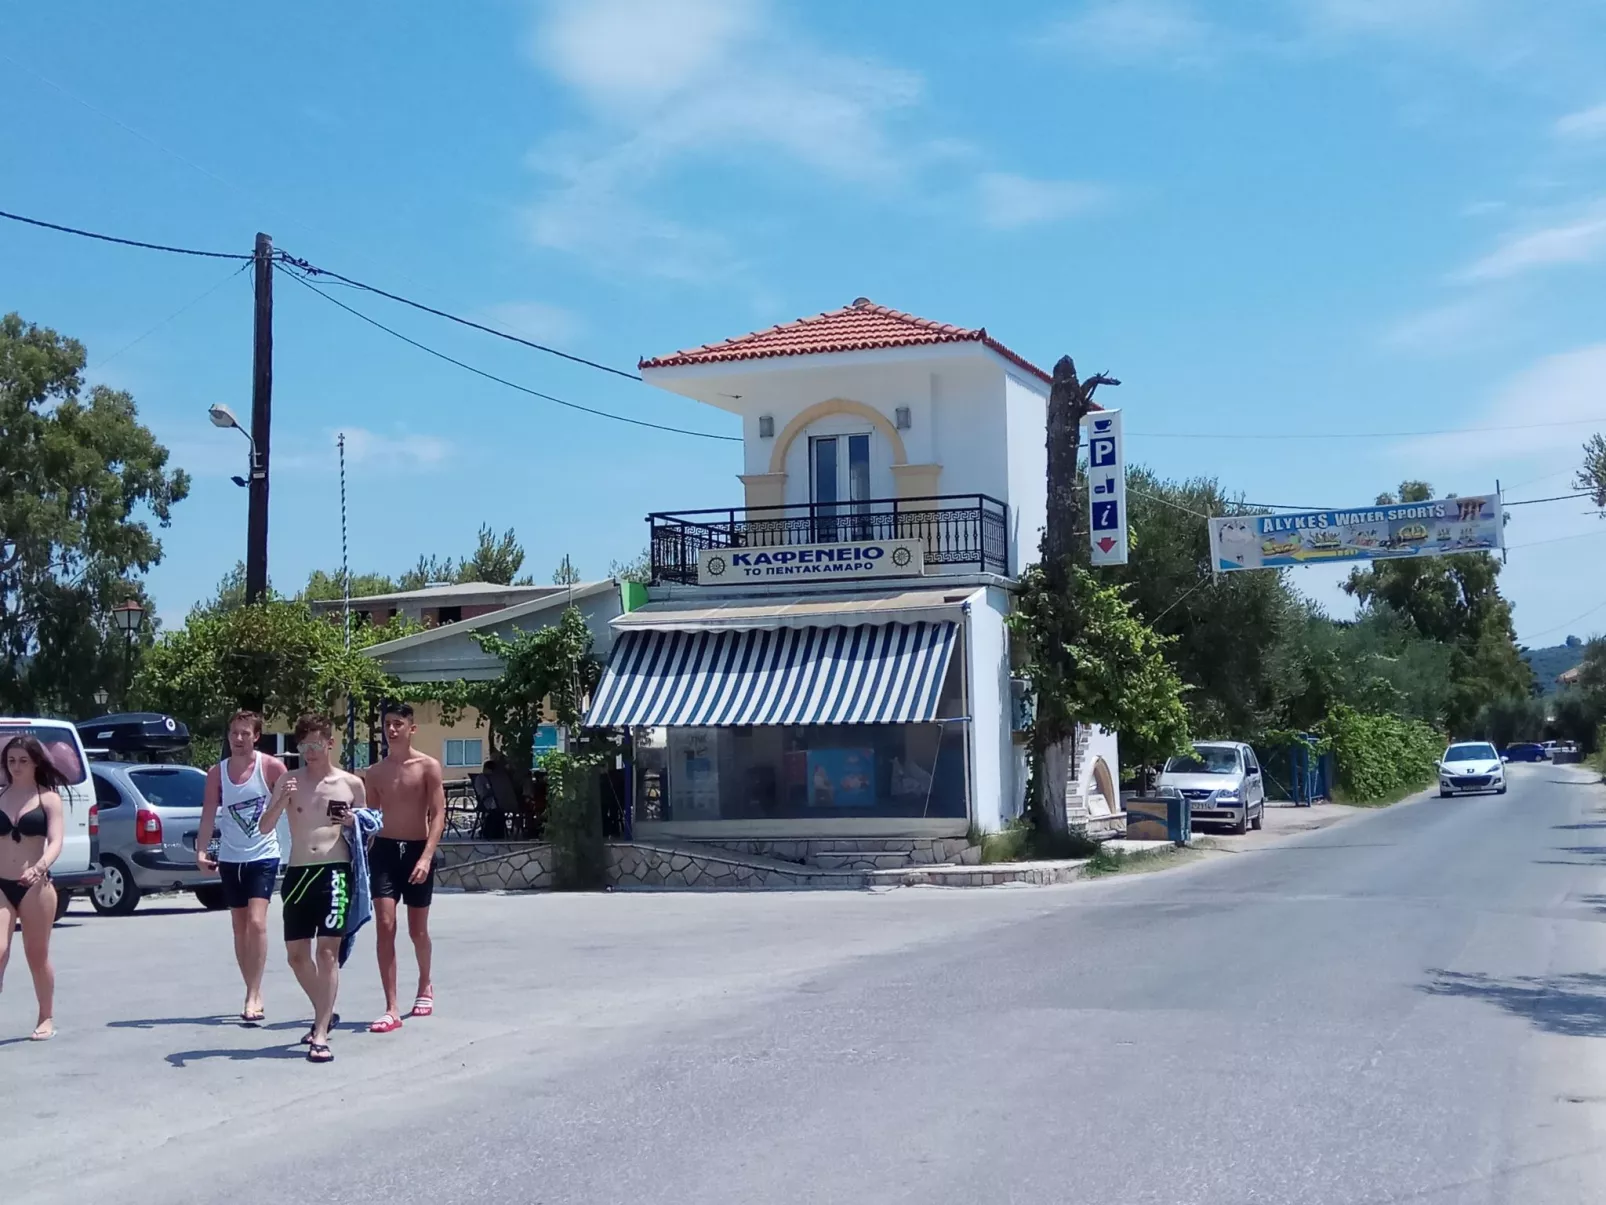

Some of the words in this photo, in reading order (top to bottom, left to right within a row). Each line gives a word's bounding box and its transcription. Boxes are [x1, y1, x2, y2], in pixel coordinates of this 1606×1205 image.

[1095, 440, 1113, 464] P
[1101, 505, 1112, 526] i
[1262, 513, 1329, 533] ALYKES
[1335, 510, 1384, 527] WATER
[1388, 504, 1446, 521] SPORTS
[732, 546, 884, 567] ΚΑΦΕΝΕΙΟ
[743, 567, 761, 576] ΤΟ
[766, 561, 873, 576] ΠΕΝΤΑΚΑΜΑΡΟ
[325, 869, 349, 929] Super
